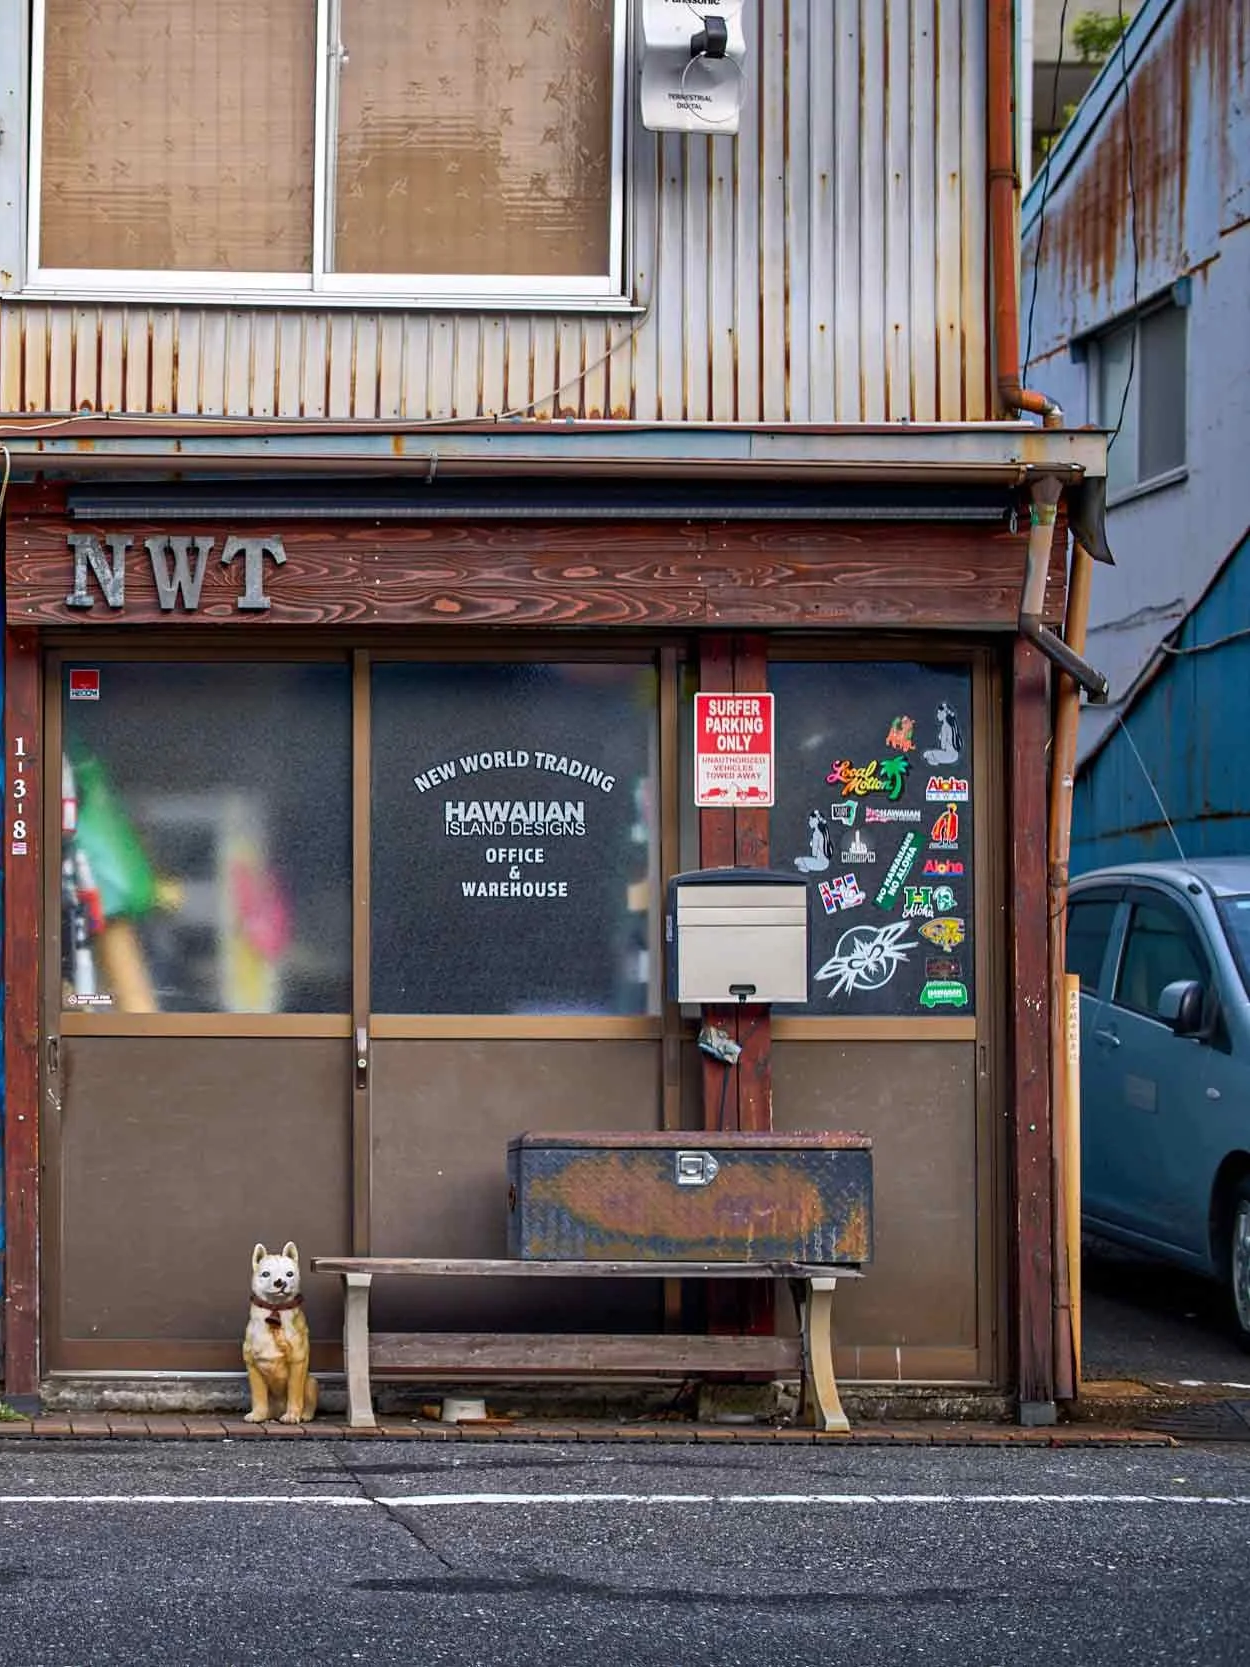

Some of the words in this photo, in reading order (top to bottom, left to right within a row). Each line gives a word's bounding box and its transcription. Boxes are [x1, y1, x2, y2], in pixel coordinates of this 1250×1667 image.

[65, 534, 287, 610] NWT
[708, 699, 760, 716] SURFER
[705, 717, 764, 734] PARKING
[717, 735, 752, 751] ONLY
[413, 760, 457, 793] NEW
[459, 750, 530, 774] WORLD
[534, 751, 617, 793] TRADING
[827, 759, 877, 783] Local
[842, 776, 893, 796] Motion
[928, 776, 967, 791] Aloha
[445, 801, 585, 822] HAWAIIAN
[445, 822, 505, 836] ISLAND
[511, 822, 586, 836] DESIGNS
[485, 848, 544, 863] OFFICE
[509, 865, 520, 880] &
[876, 887, 887, 904] NO
[884, 832, 915, 887] HAWAIIANS
[888, 881, 899, 896] NO
[897, 847, 917, 880] ALOHA
[923, 860, 964, 874] Aloha
[462, 882, 568, 897] WAREHOUSE
[902, 901, 934, 918] Aloha
